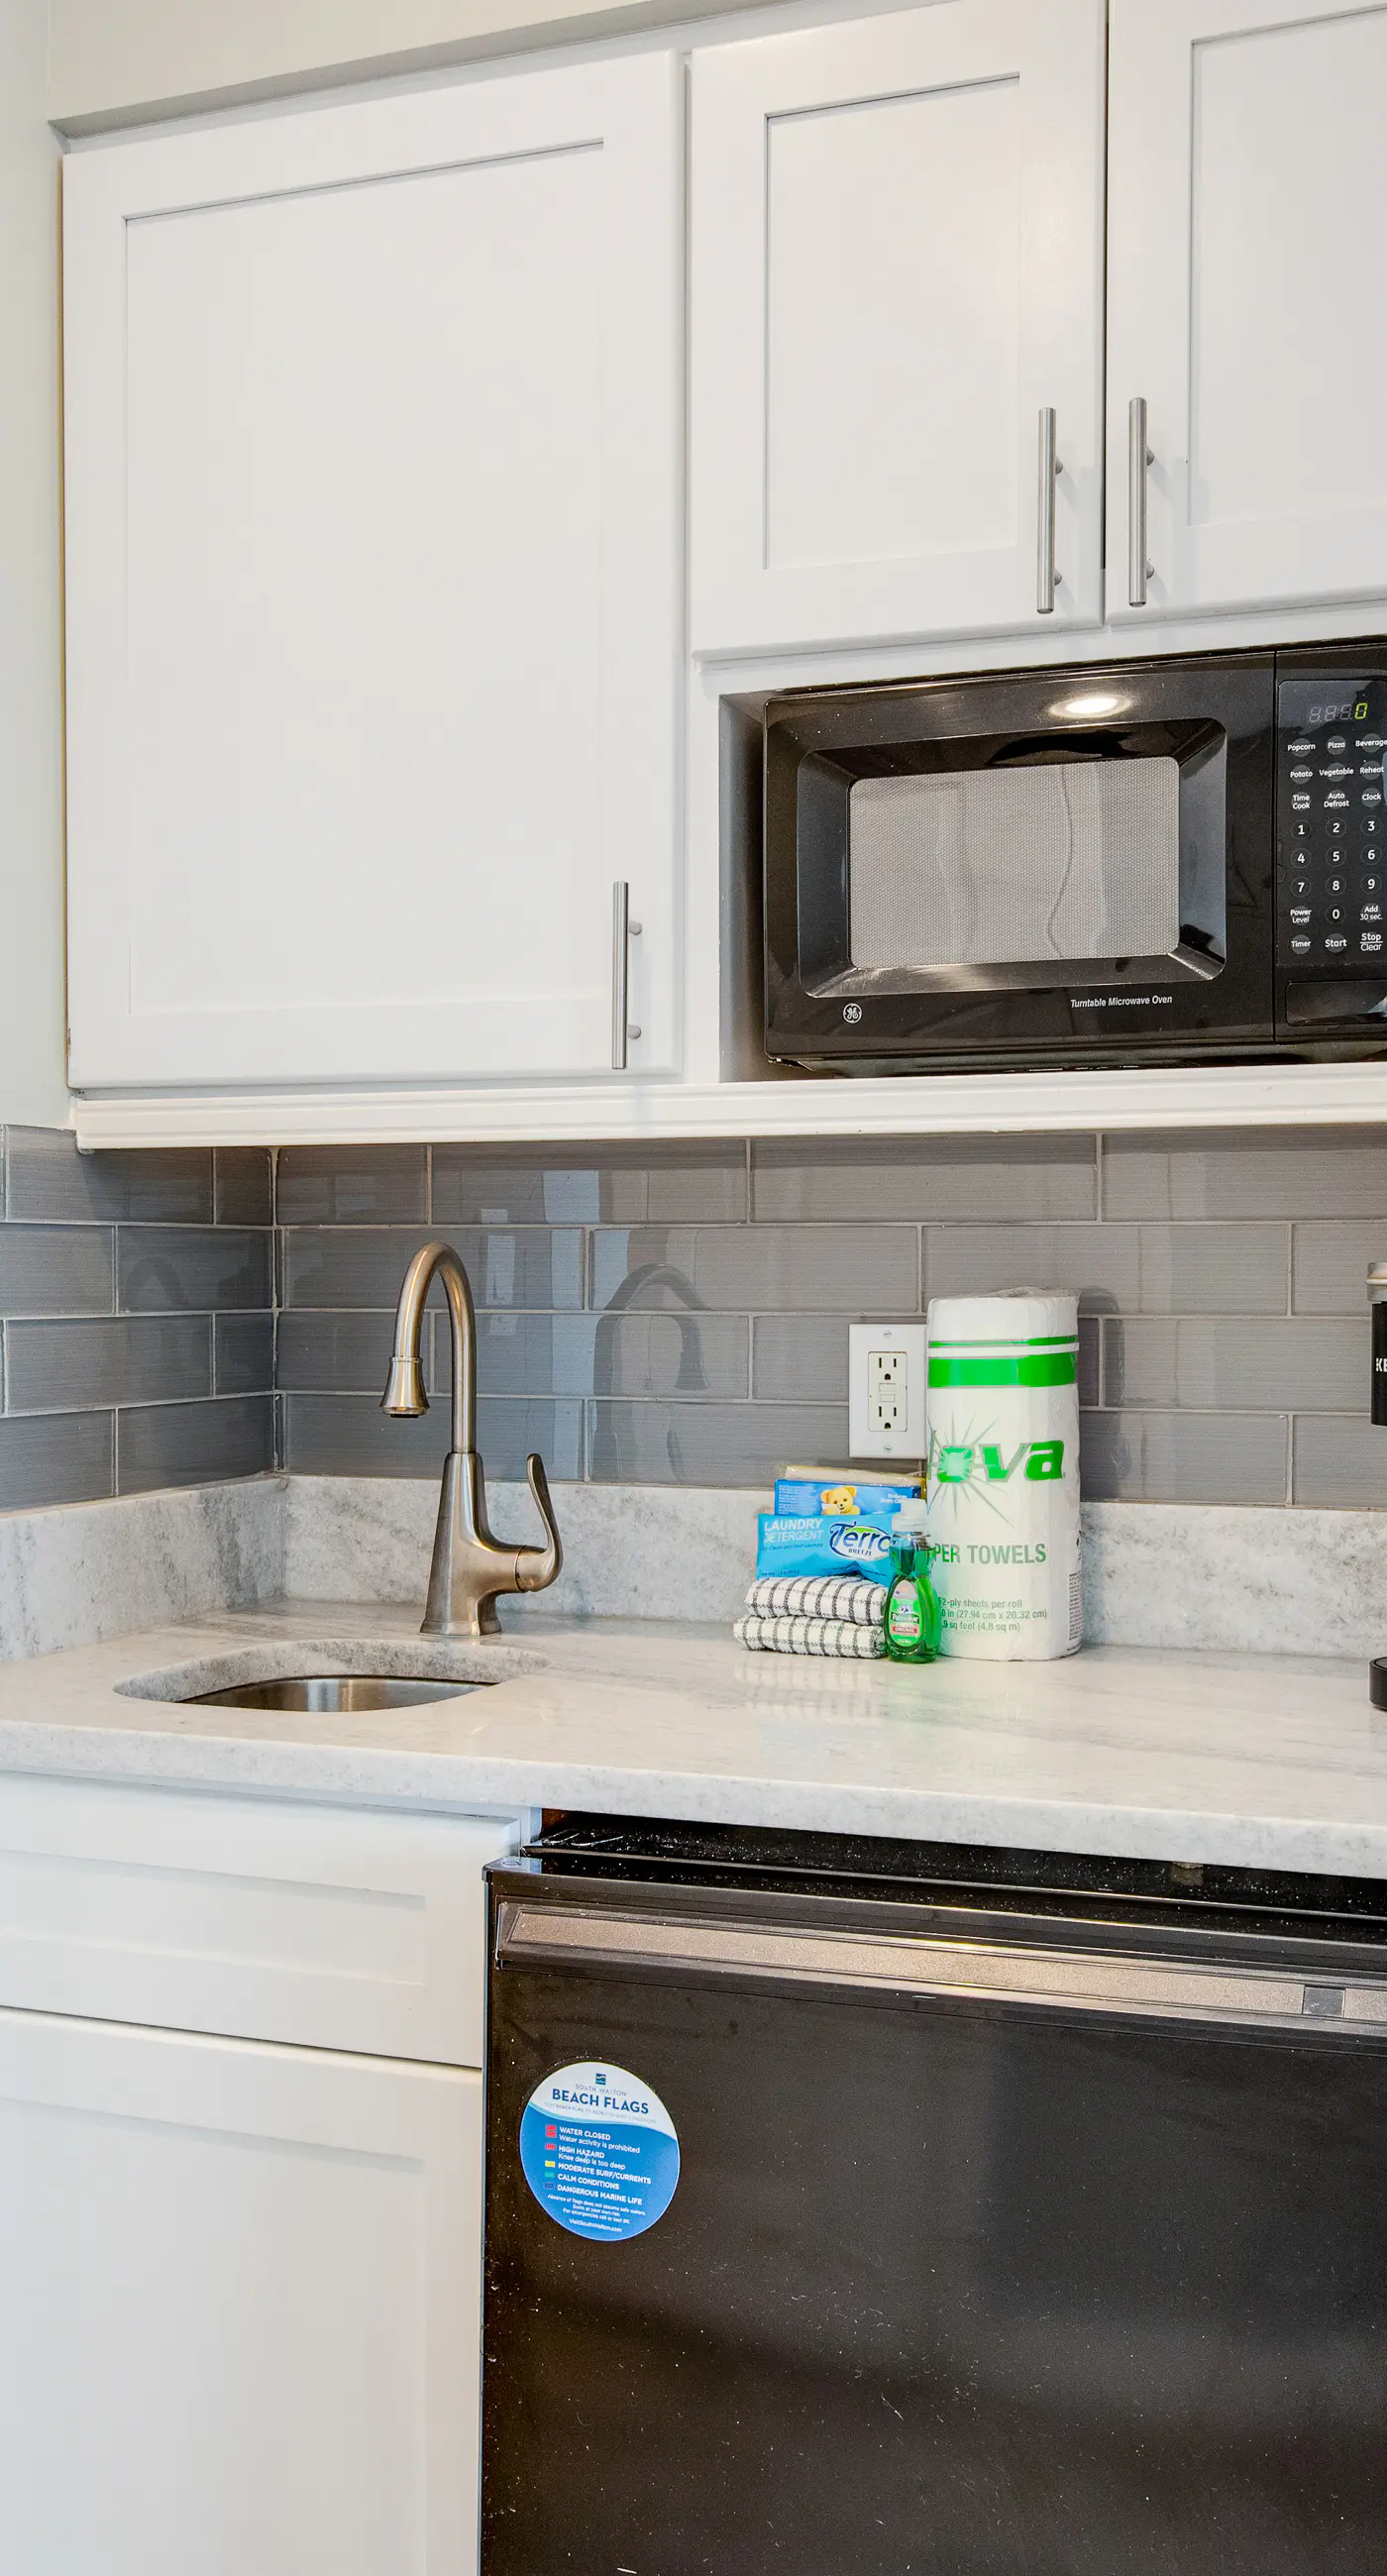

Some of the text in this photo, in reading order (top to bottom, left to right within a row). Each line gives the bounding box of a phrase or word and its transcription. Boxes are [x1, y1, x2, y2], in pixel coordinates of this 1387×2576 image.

[1288, 743, 1316, 751] Popcorn
[1319, 768, 1354, 777] Vegetable
[1298, 825, 1305, 835] 1
[1333, 823, 1339, 833] 2
[1368, 821, 1375, 831] 3
[1297, 853, 1305, 863] 4
[1333, 851, 1340, 861] 5
[1368, 850, 1375, 860] 6
[1298, 882, 1305, 892] 7
[1333, 880, 1340, 891] 8
[1368, 879, 1375, 889] 9
[1332, 910, 1340, 919] 0
[1361, 933, 1382, 942] Stop
[1325, 939, 1347, 948] Start
[1070, 995, 1173, 1008] Turntable Microwave Oven
[764, 1518, 824, 1531] LAUNDRY
[763, 1530, 824, 1543] DETERGENT
[967, 1544, 1047, 1564] TOWELS
[963, 1599, 988, 1608] sheets
[992, 1601, 1006, 1610] per
[1008, 1600, 1022, 1608] roll
[948, 1609, 955, 1618] in
[957, 1610, 980, 1620] (27.94
[1006, 1610, 1030, 1620] 20.32
[1032, 1609, 1048, 1619] cm)
[950, 1622, 958, 1630] sq
[960, 1621, 976, 1630] feet
[978, 1622, 994, 1632] (4.8
[996, 1624, 1006, 1632] sq
[1009, 1622, 1020, 1632] m)
[576, 2084, 627, 2097] SOUTH WALTON
[552, 2088, 649, 2114] BEACH FLAGS
[559, 2126, 611, 2141] WATER CLOSED
[579, 2138, 601, 2147] activity
[608, 2144, 640, 2153] prohibited
[558, 2145, 605, 2158] HIGH HAZARD
[558, 2162, 651, 2184] MODERATE SURF/CURRENTS
[557, 2173, 620, 2190] CALM CONDITIONS
[557, 2184, 642, 2205] DANGEROUS MARINE LIFE
[569, 2218, 623, 2233] VisitSouthWalton.com
